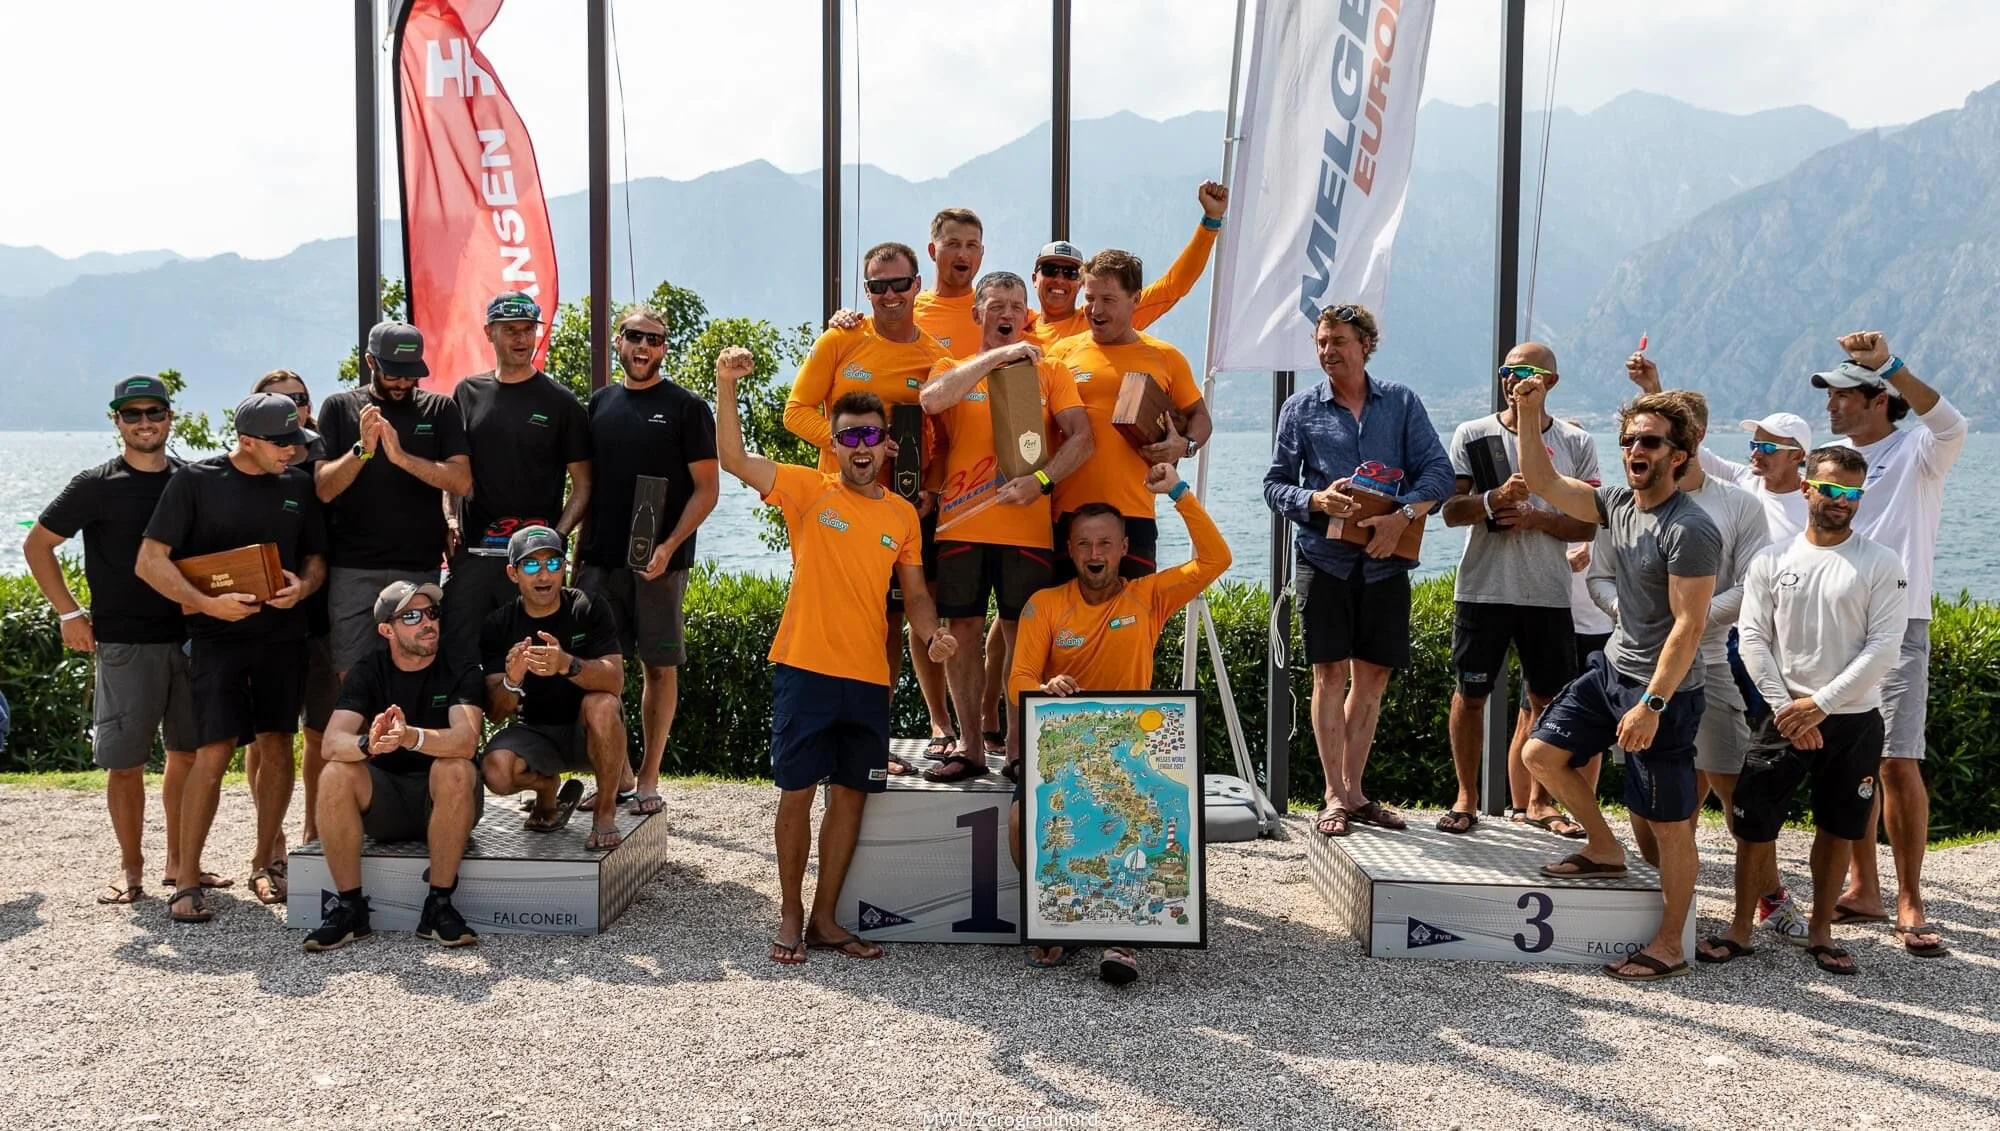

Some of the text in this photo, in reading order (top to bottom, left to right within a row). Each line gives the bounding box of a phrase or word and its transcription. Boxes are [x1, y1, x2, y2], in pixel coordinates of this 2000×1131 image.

[1353, 0, 1401, 197] EURO
[477, 128, 543, 337] NSEN
[943, 455, 995, 503] 32
[951, 806, 1017, 934] 1
[493, 911, 578, 926] FALCONERI
[1513, 891, 1555, 953] 3
